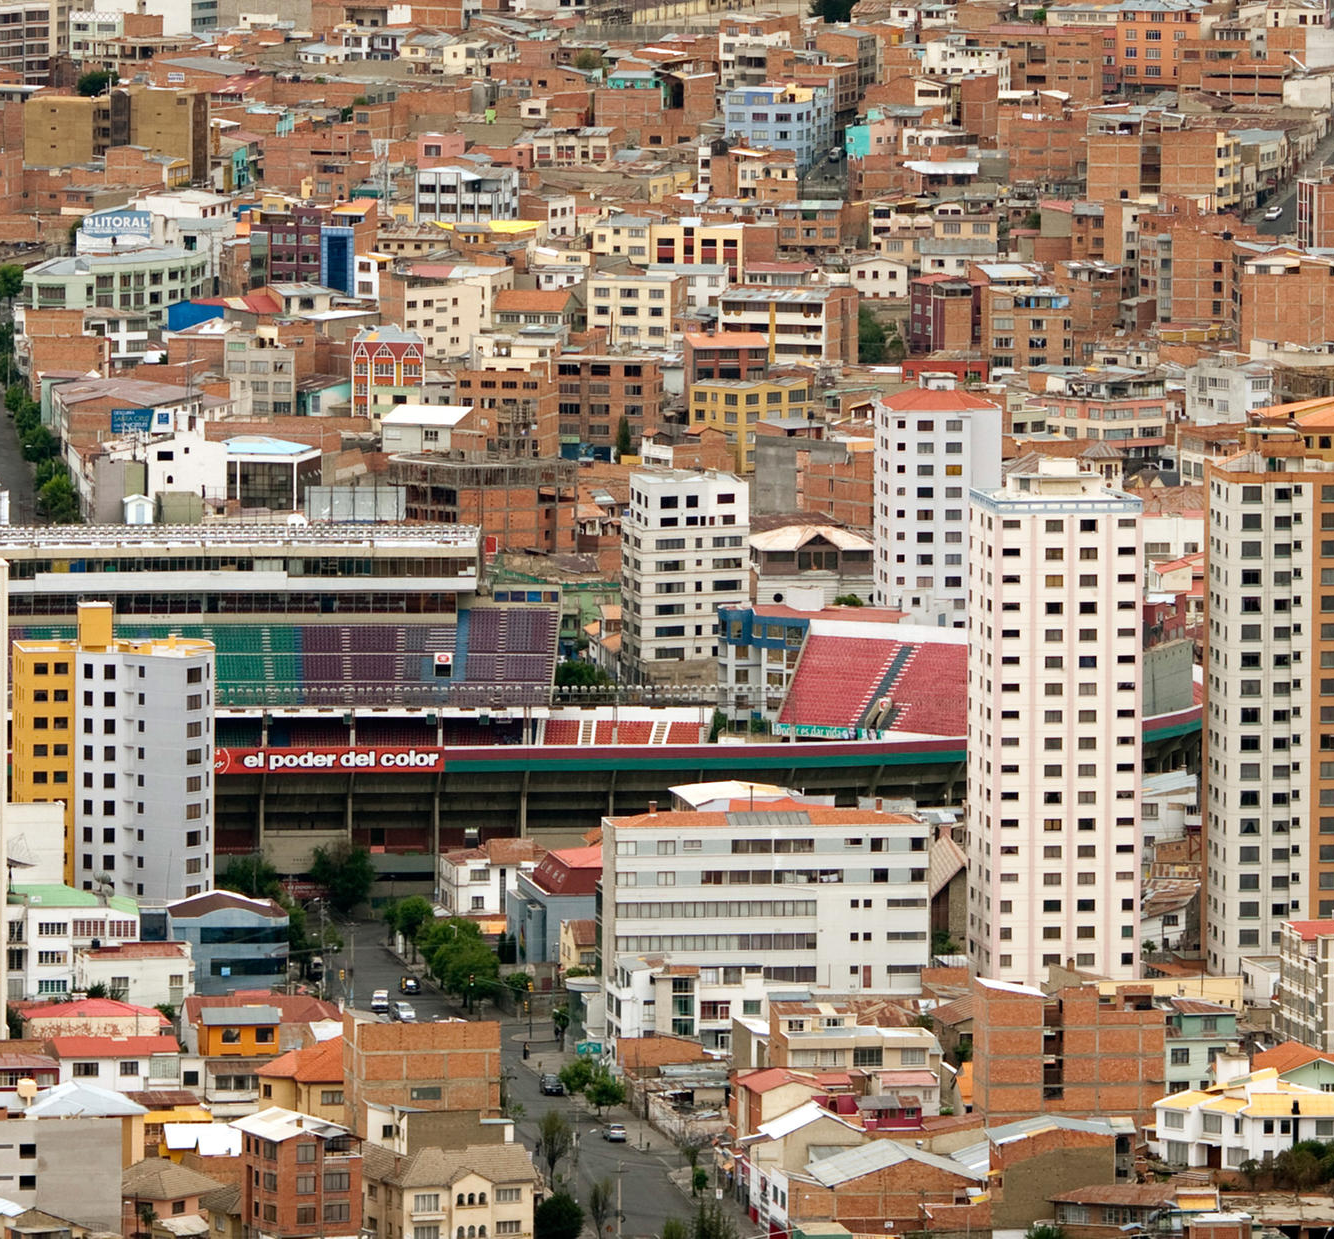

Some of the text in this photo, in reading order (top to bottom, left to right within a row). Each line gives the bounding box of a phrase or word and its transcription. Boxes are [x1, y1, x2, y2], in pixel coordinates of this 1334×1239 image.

[94, 216, 148, 227] LITORAL
[243, 751, 264, 768] el
[269, 751, 337, 771] poder
[339, 750, 376, 767] del
[380, 749, 439, 767] color
